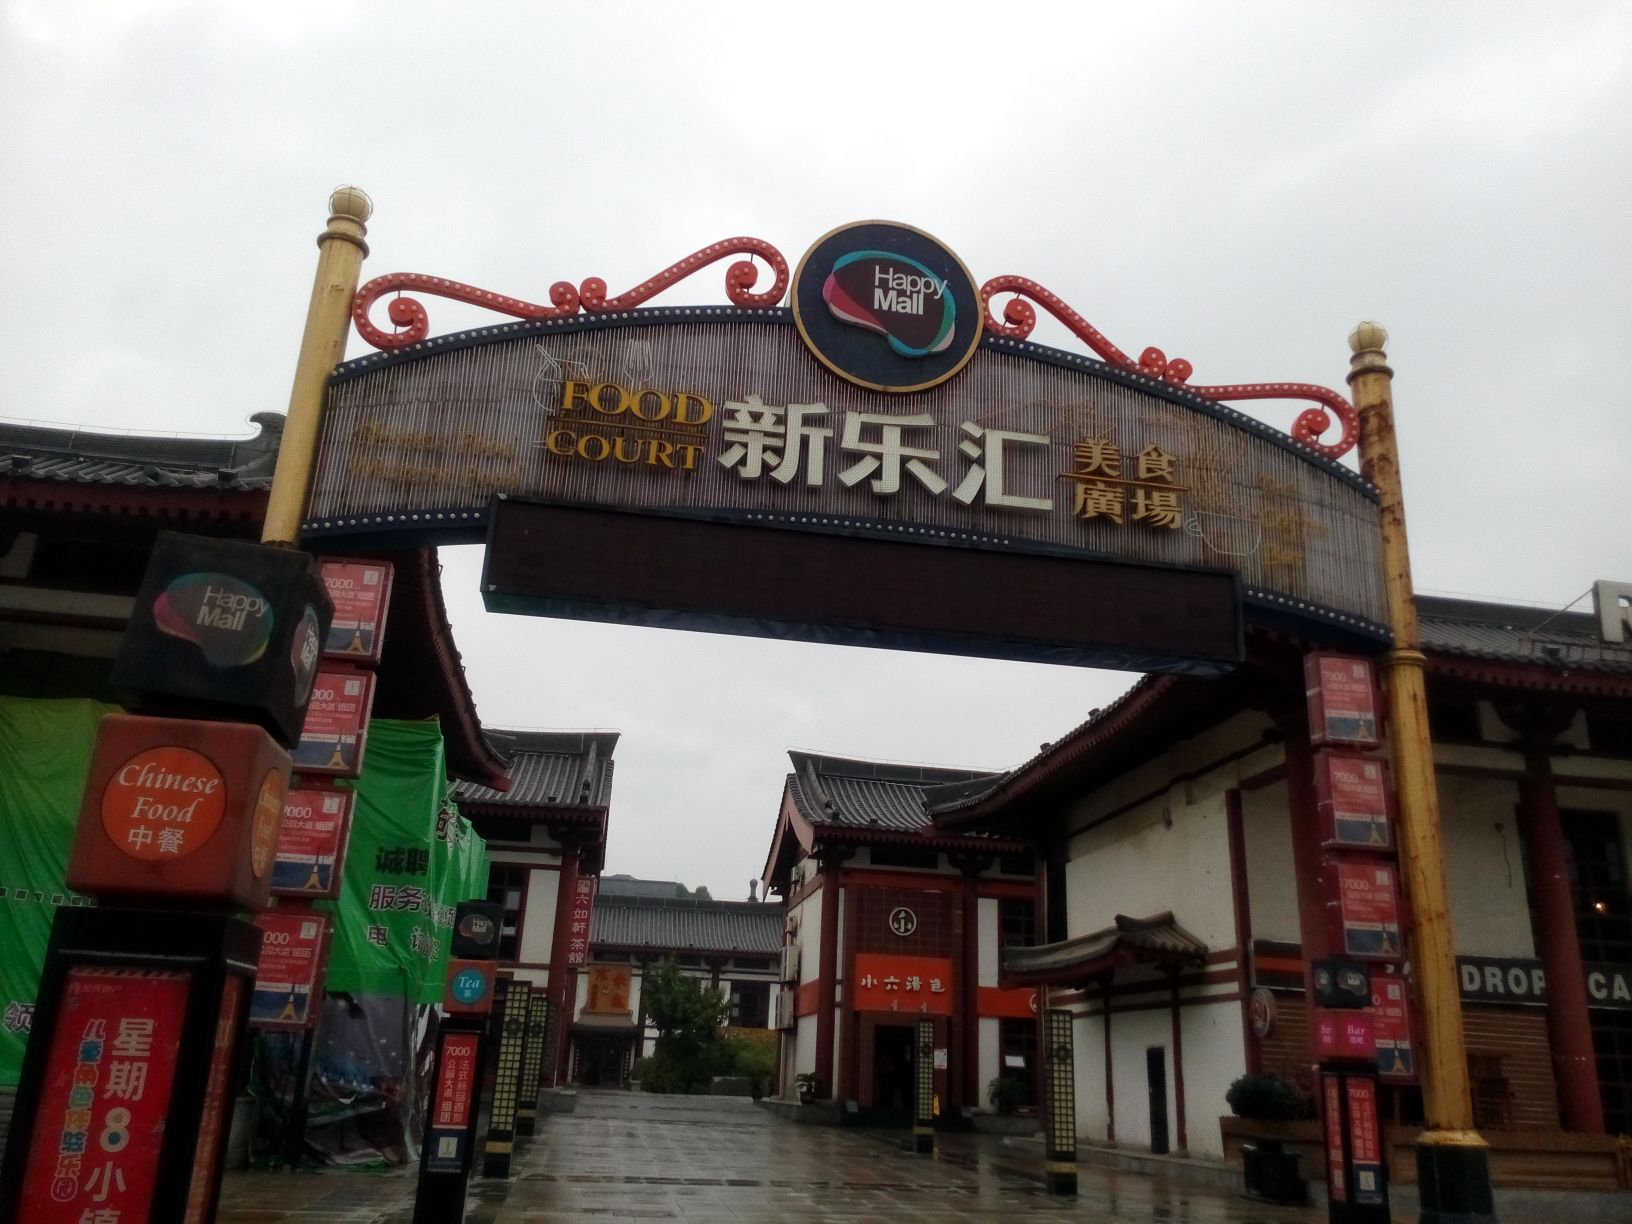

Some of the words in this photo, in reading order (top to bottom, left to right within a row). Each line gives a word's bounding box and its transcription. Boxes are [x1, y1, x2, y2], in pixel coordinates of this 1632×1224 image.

[874, 264, 948, 300] Happy
[873, 288, 924, 315] Mall
[561, 380, 714, 425] FOOD
[546, 429, 705, 470] COURT
[717, 393, 1053, 511] 新乐汇
[1075, 438, 1178, 482] 美食
[1073, 482, 1181, 529] 廣場
[203, 585, 270, 618] Happy
[196, 605, 245, 631] Mall
[311, 689, 334, 700] 000
[118, 762, 219, 794] Chinese
[129, 796, 204, 823] Food
[128, 824, 185, 854] 中餐
[263, 931, 290, 945] 000
[459, 976, 481, 988] Tea
[1461, 963, 1547, 996] DROP
[1346, 1024, 1367, 1037] Bar
[446, 1046, 471, 1057] 7000
